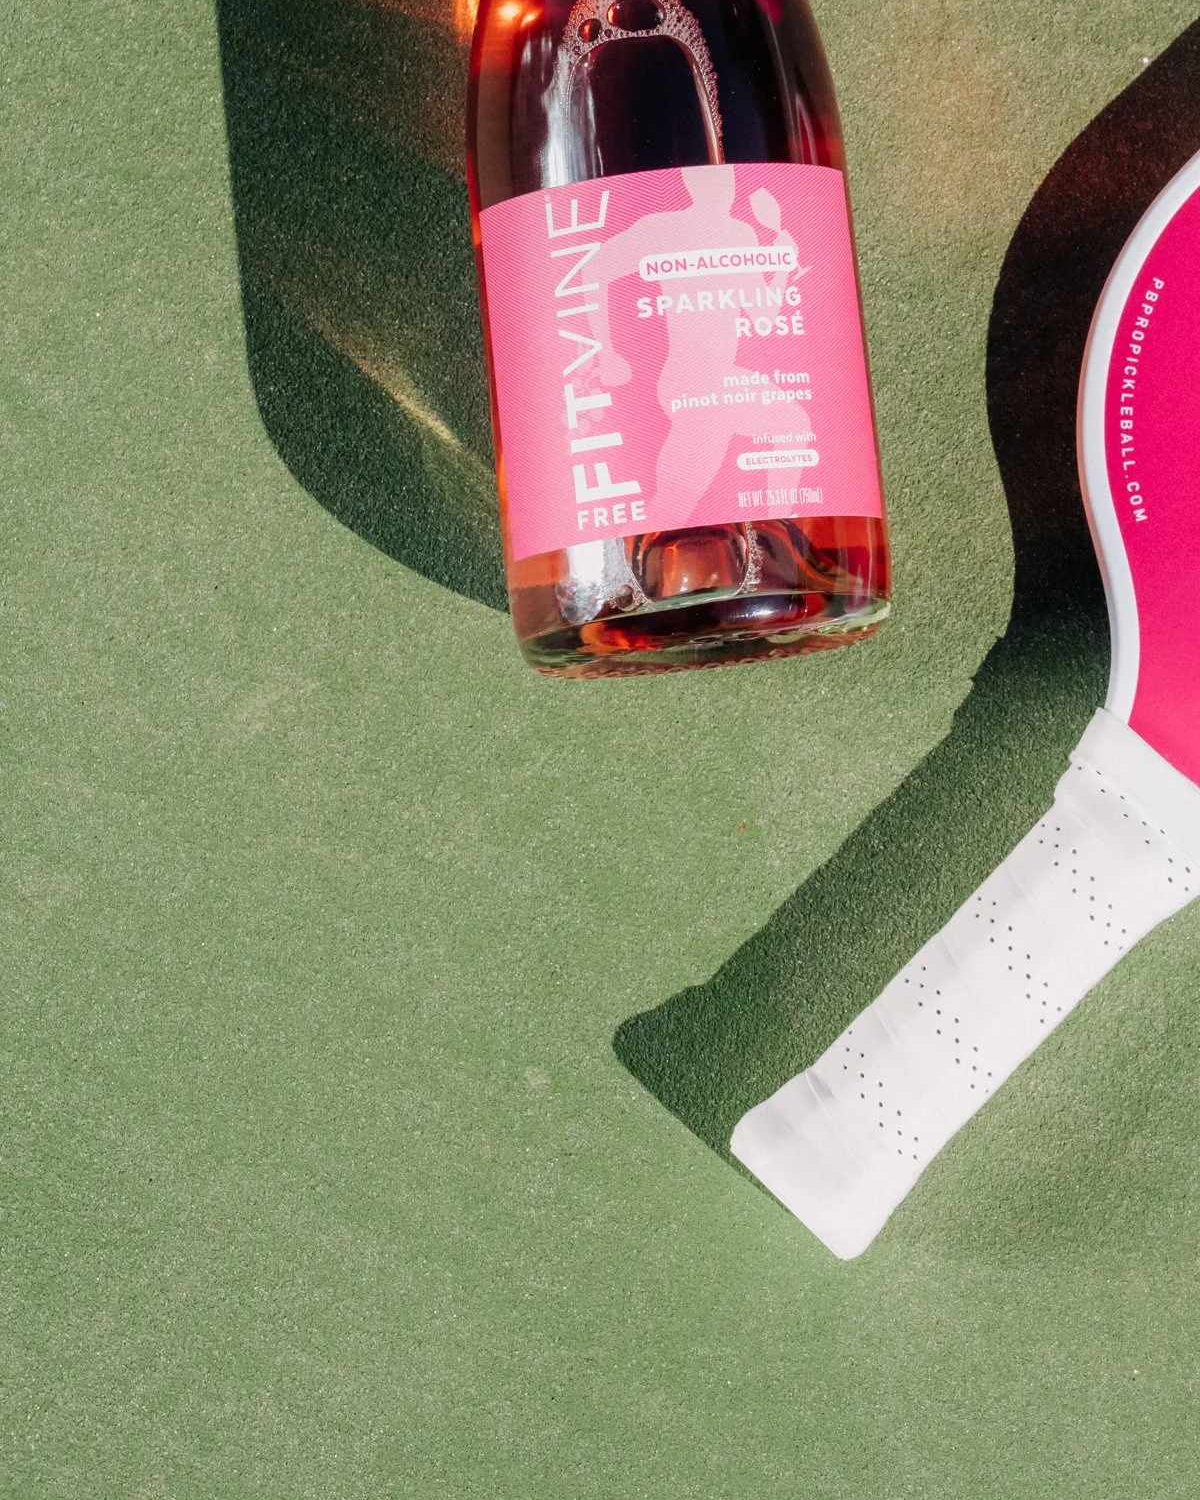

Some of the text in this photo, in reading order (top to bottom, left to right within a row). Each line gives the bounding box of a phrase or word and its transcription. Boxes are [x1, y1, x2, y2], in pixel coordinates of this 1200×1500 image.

[645, 252, 792, 276] NON-ALCOHOLIC
[636, 285, 802, 319] SPARKLING
[735, 310, 805, 338] ROSÉ
[545, 190, 643, 505] FITVINE
[723, 369, 810, 388] made from
[671, 388, 812, 413] pinot noir grapes
[1119, 276, 1165, 523] PBPROPICKLEBALL.COM
[753, 431, 817, 445] infused with
[745, 453, 813, 466] ELECTROLYTES
[738, 491, 751, 508] NET
[576, 500, 647, 532] FREE
